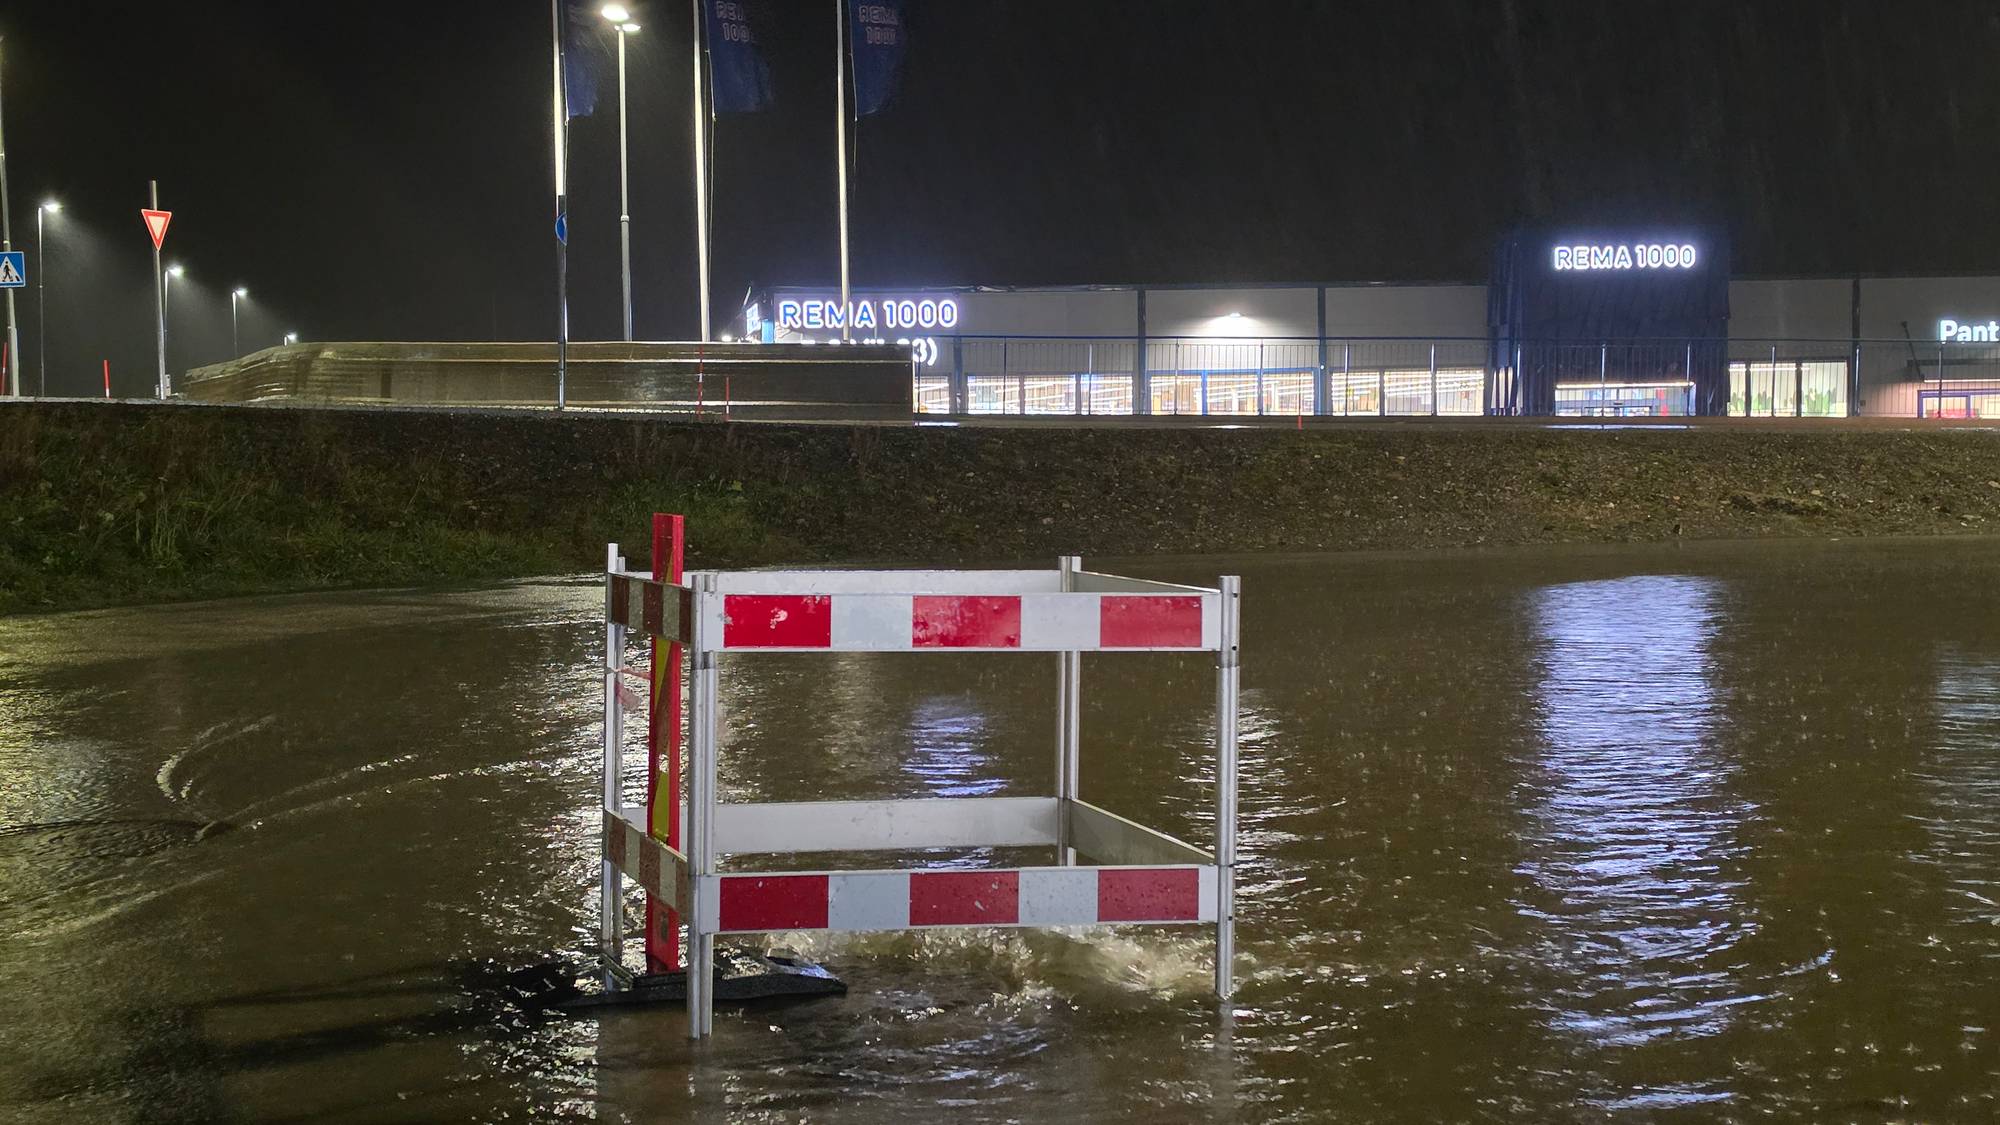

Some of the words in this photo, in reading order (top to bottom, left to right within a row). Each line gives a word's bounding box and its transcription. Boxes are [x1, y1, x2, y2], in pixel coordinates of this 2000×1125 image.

[1554, 245, 1633, 270] REMA
[1635, 244, 1696, 269] 1000
[779, 300, 877, 329] REMA
[883, 299, 958, 329] 1000
[1940, 319, 2000, 344] Pant
